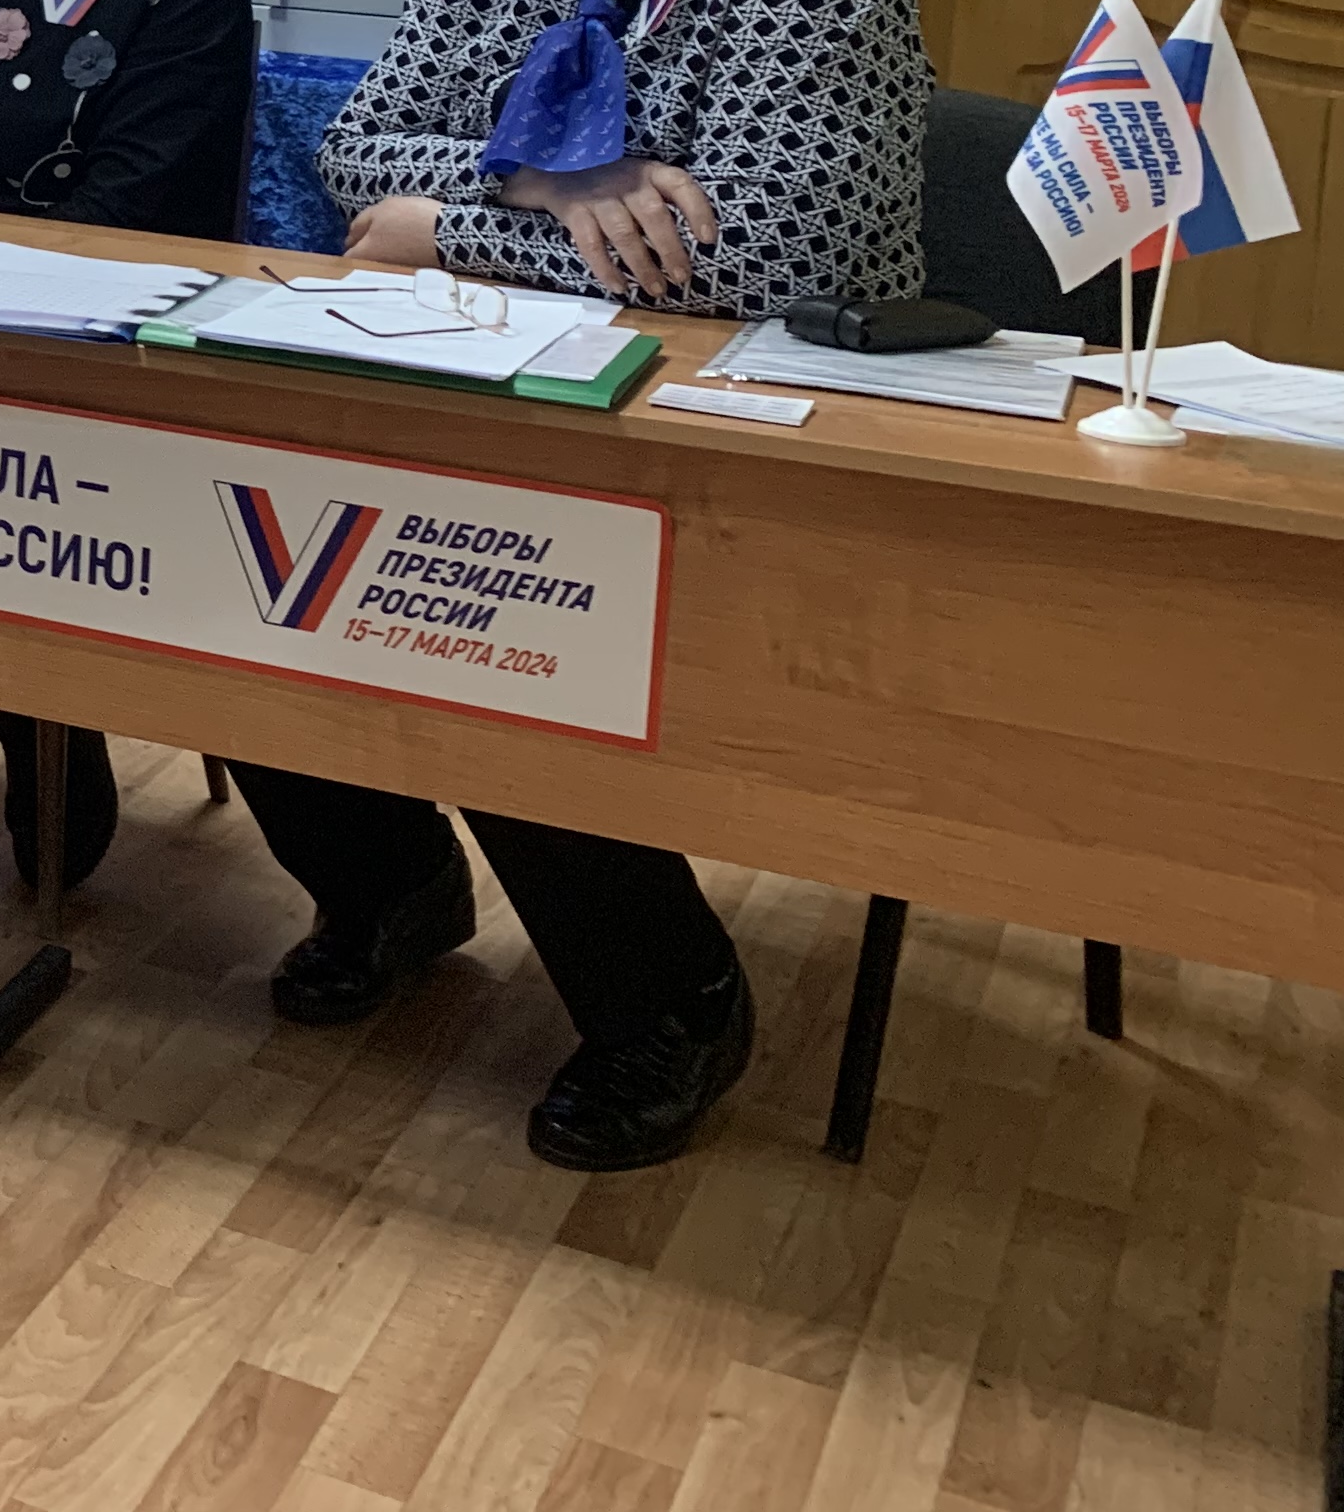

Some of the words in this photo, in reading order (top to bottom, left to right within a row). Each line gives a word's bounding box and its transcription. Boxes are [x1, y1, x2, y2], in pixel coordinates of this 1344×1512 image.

[1041, 132, 1067, 161] МЫ
[1058, 161, 1091, 203] СИЛА
[1088, 102, 1139, 170] РОССИИ
[1115, 101, 1166, 208] ПРЕЗИДЕНТА
[1140, 101, 1183, 175] ВЫБОРЫ
[1026, 151, 1044, 172] ЗА
[1035, 169, 1085, 238] РОССИЮ!
[1086, 139, 1120, 181] МАРТА
[1109, 184, 1131, 213] 2024
[396, 514, 554, 564] ВЫБОРЫ
[357, 584, 498, 632] РОССИИ
[376, 549, 596, 612] ПРЕЗИДЕНТА
[410, 630, 495, 667] МАРТА
[495, 647, 559, 678] 2024
